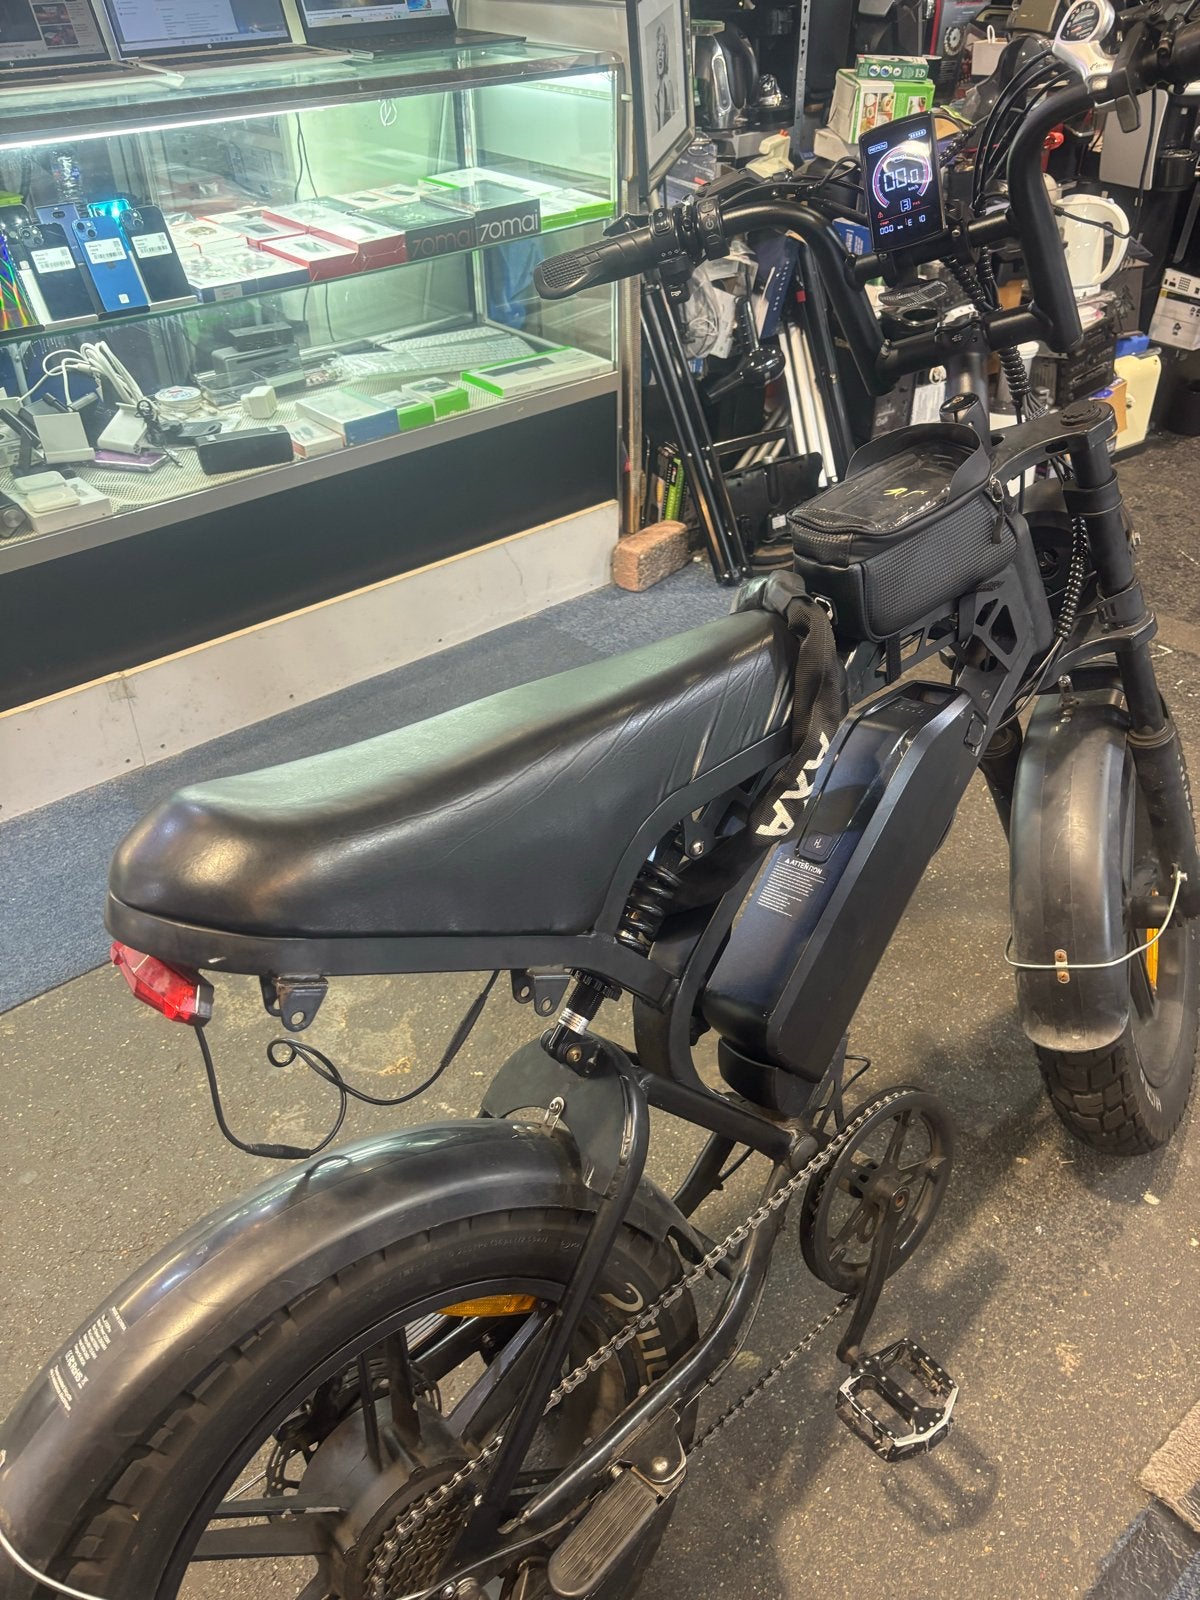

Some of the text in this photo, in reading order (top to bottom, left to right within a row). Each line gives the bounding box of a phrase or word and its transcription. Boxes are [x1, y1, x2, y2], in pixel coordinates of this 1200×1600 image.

[480, 209, 539, 242] 70mai
[411, 227, 475, 258] 70mai
[789, 859, 823, 875] ATTENTION
